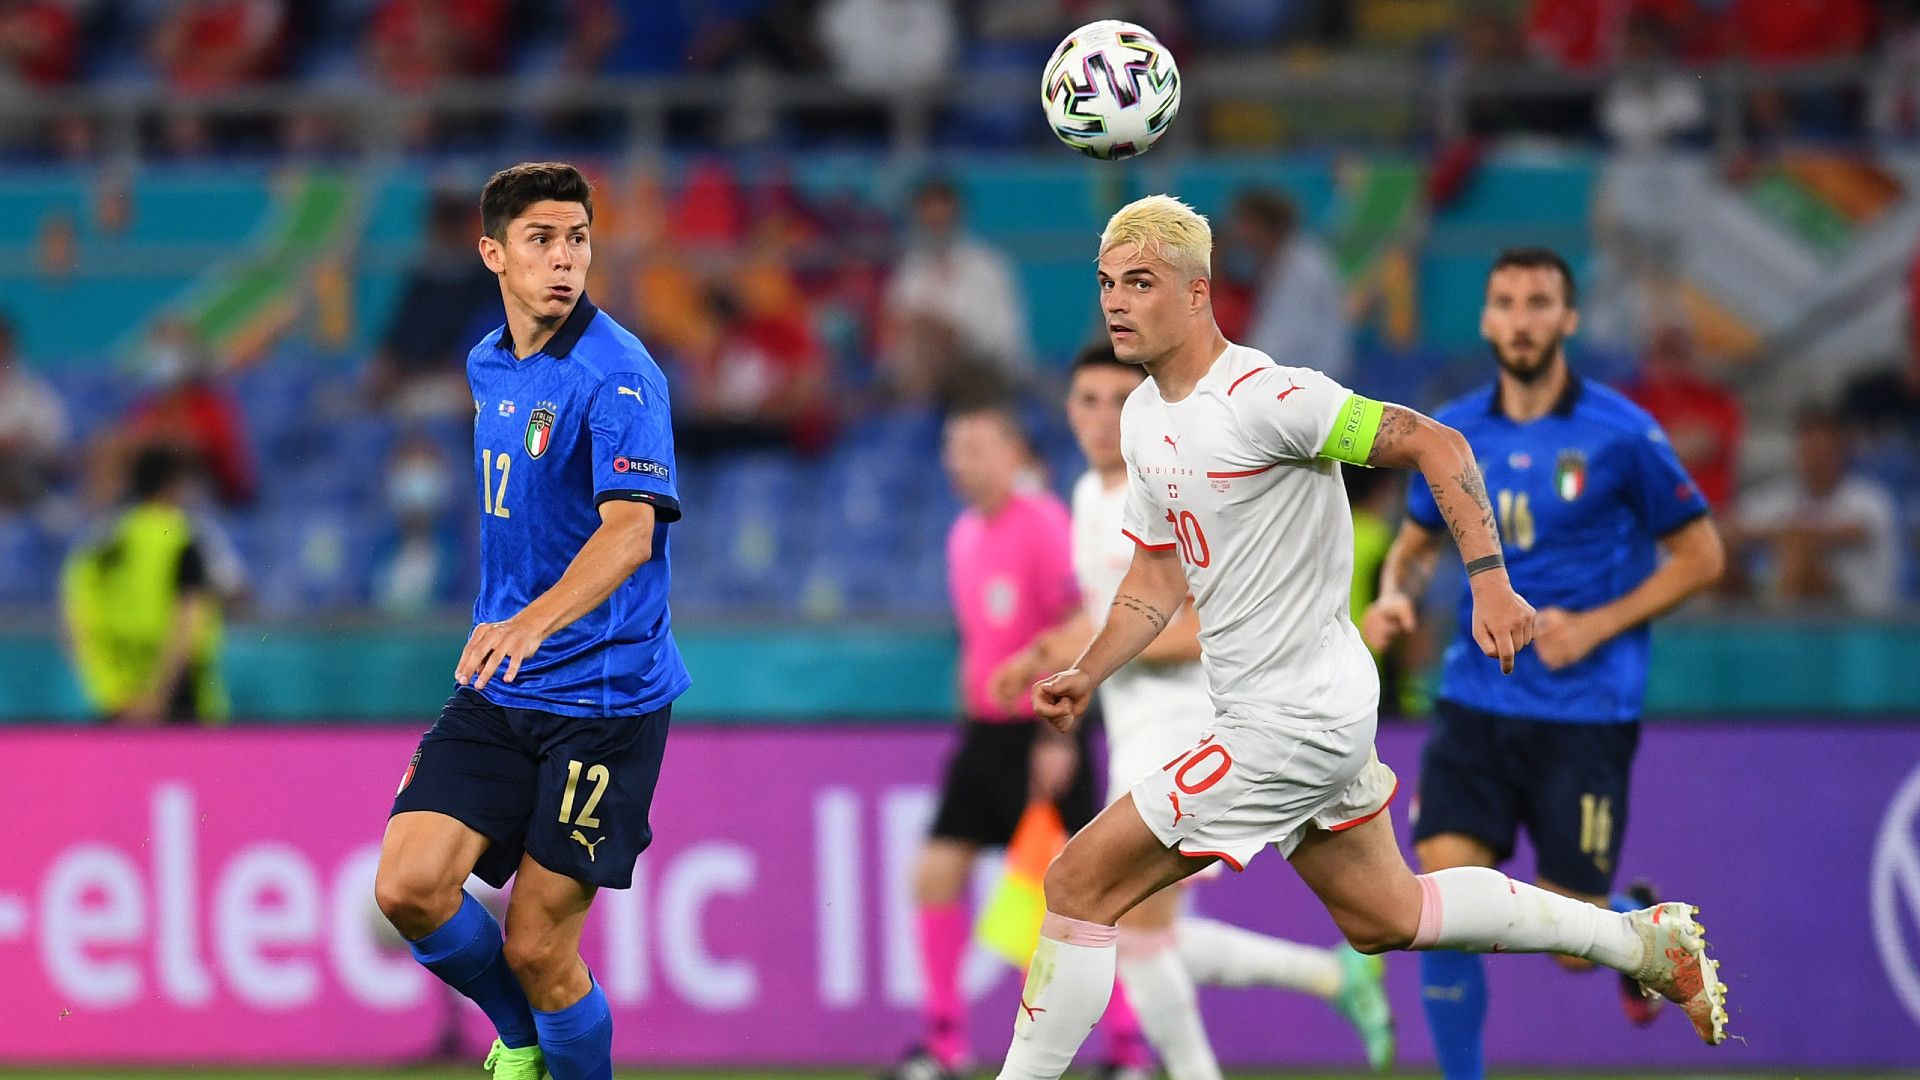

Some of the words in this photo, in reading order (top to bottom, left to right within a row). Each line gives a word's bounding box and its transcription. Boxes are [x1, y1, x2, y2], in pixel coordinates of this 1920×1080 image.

[482, 448, 511, 518] 12
[630, 461, 669, 477] RESPECT
[1165, 508, 1210, 569] 10
[558, 759, 610, 829] 12
[1163, 733, 1232, 795] 10
